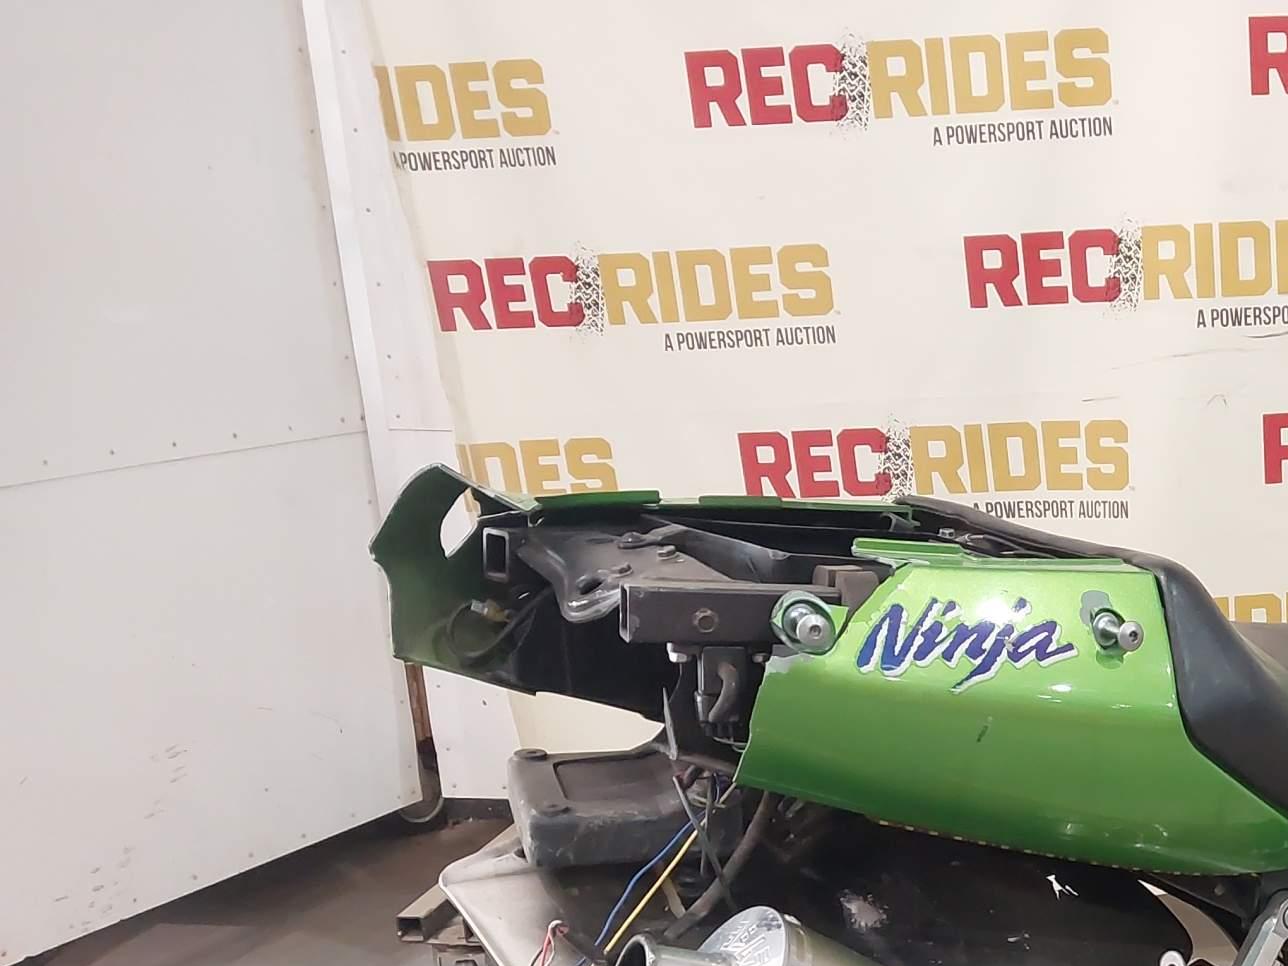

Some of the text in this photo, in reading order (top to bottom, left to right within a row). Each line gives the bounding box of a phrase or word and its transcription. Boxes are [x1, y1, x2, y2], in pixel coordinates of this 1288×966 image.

[685, 28, 1112, 128] REC RIDES
[399, 148, 495, 172] POWERSPORT
[499, 145, 557, 169] AUCTION
[933, 116, 1113, 147] A POWERSPORT AUCTION
[427, 245, 833, 332] REC RIDES
[964, 229, 1120, 308] REC
[664, 324, 837, 352] A POWERSPORT AUCTION
[1196, 308, 1207, 328] A
[739, 420, 1129, 498] REC RIDES
[985, 501, 1075, 519] POWERSPORT
[1078, 500, 1129, 519] AUCTION
[856, 596, 1079, 695] Ninja
